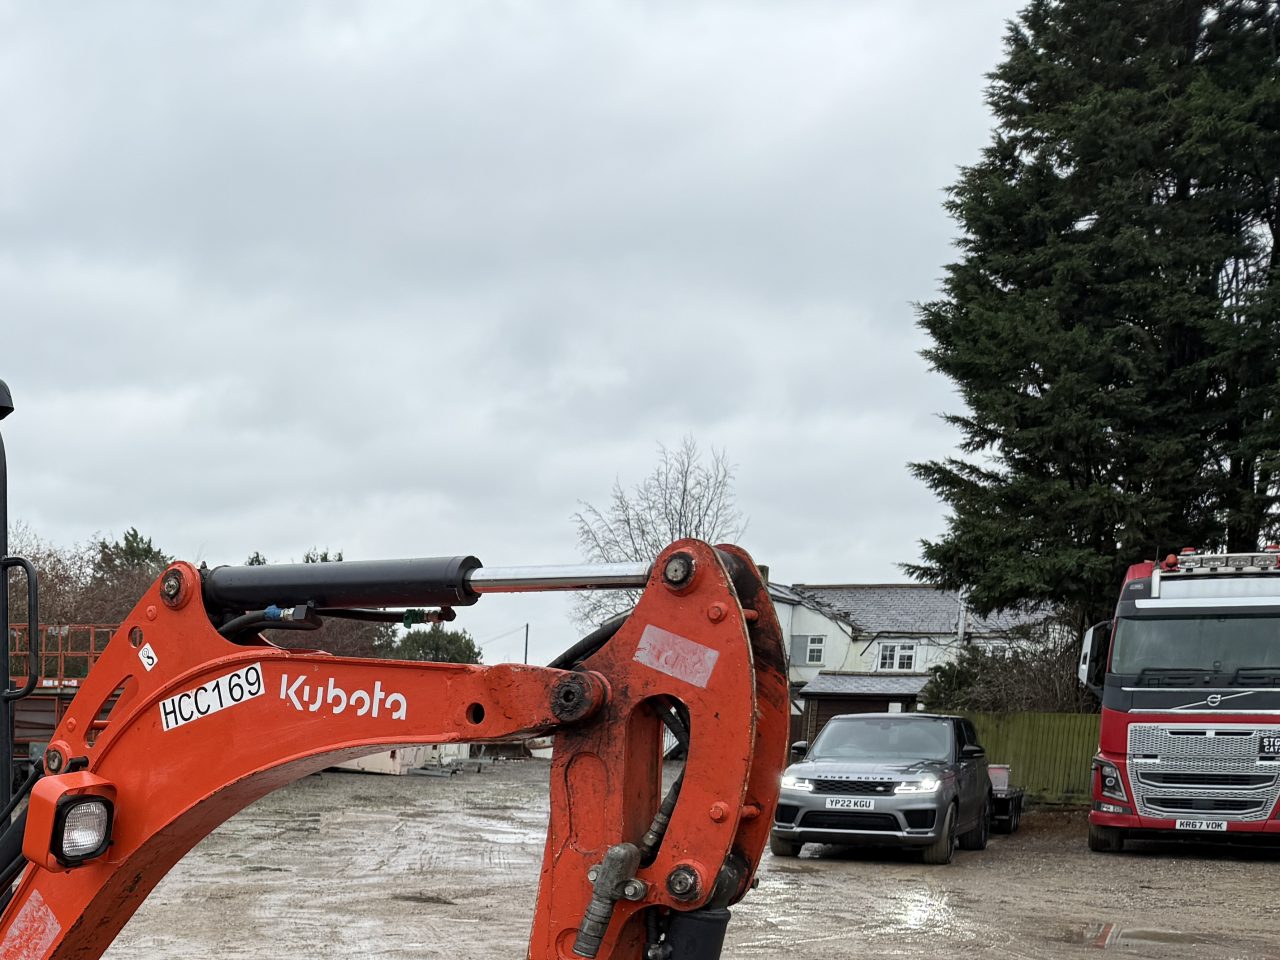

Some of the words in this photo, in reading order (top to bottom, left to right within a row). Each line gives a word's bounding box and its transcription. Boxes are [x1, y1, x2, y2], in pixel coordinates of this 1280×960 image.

[162, 665, 263, 728] HCC169
[280, 673, 407, 721] Kubota
[829, 799, 852, 808] YP22
[853, 800, 871, 809] KGU
[1179, 821, 1203, 829] KR67
[1205, 822, 1223, 830] VOK
